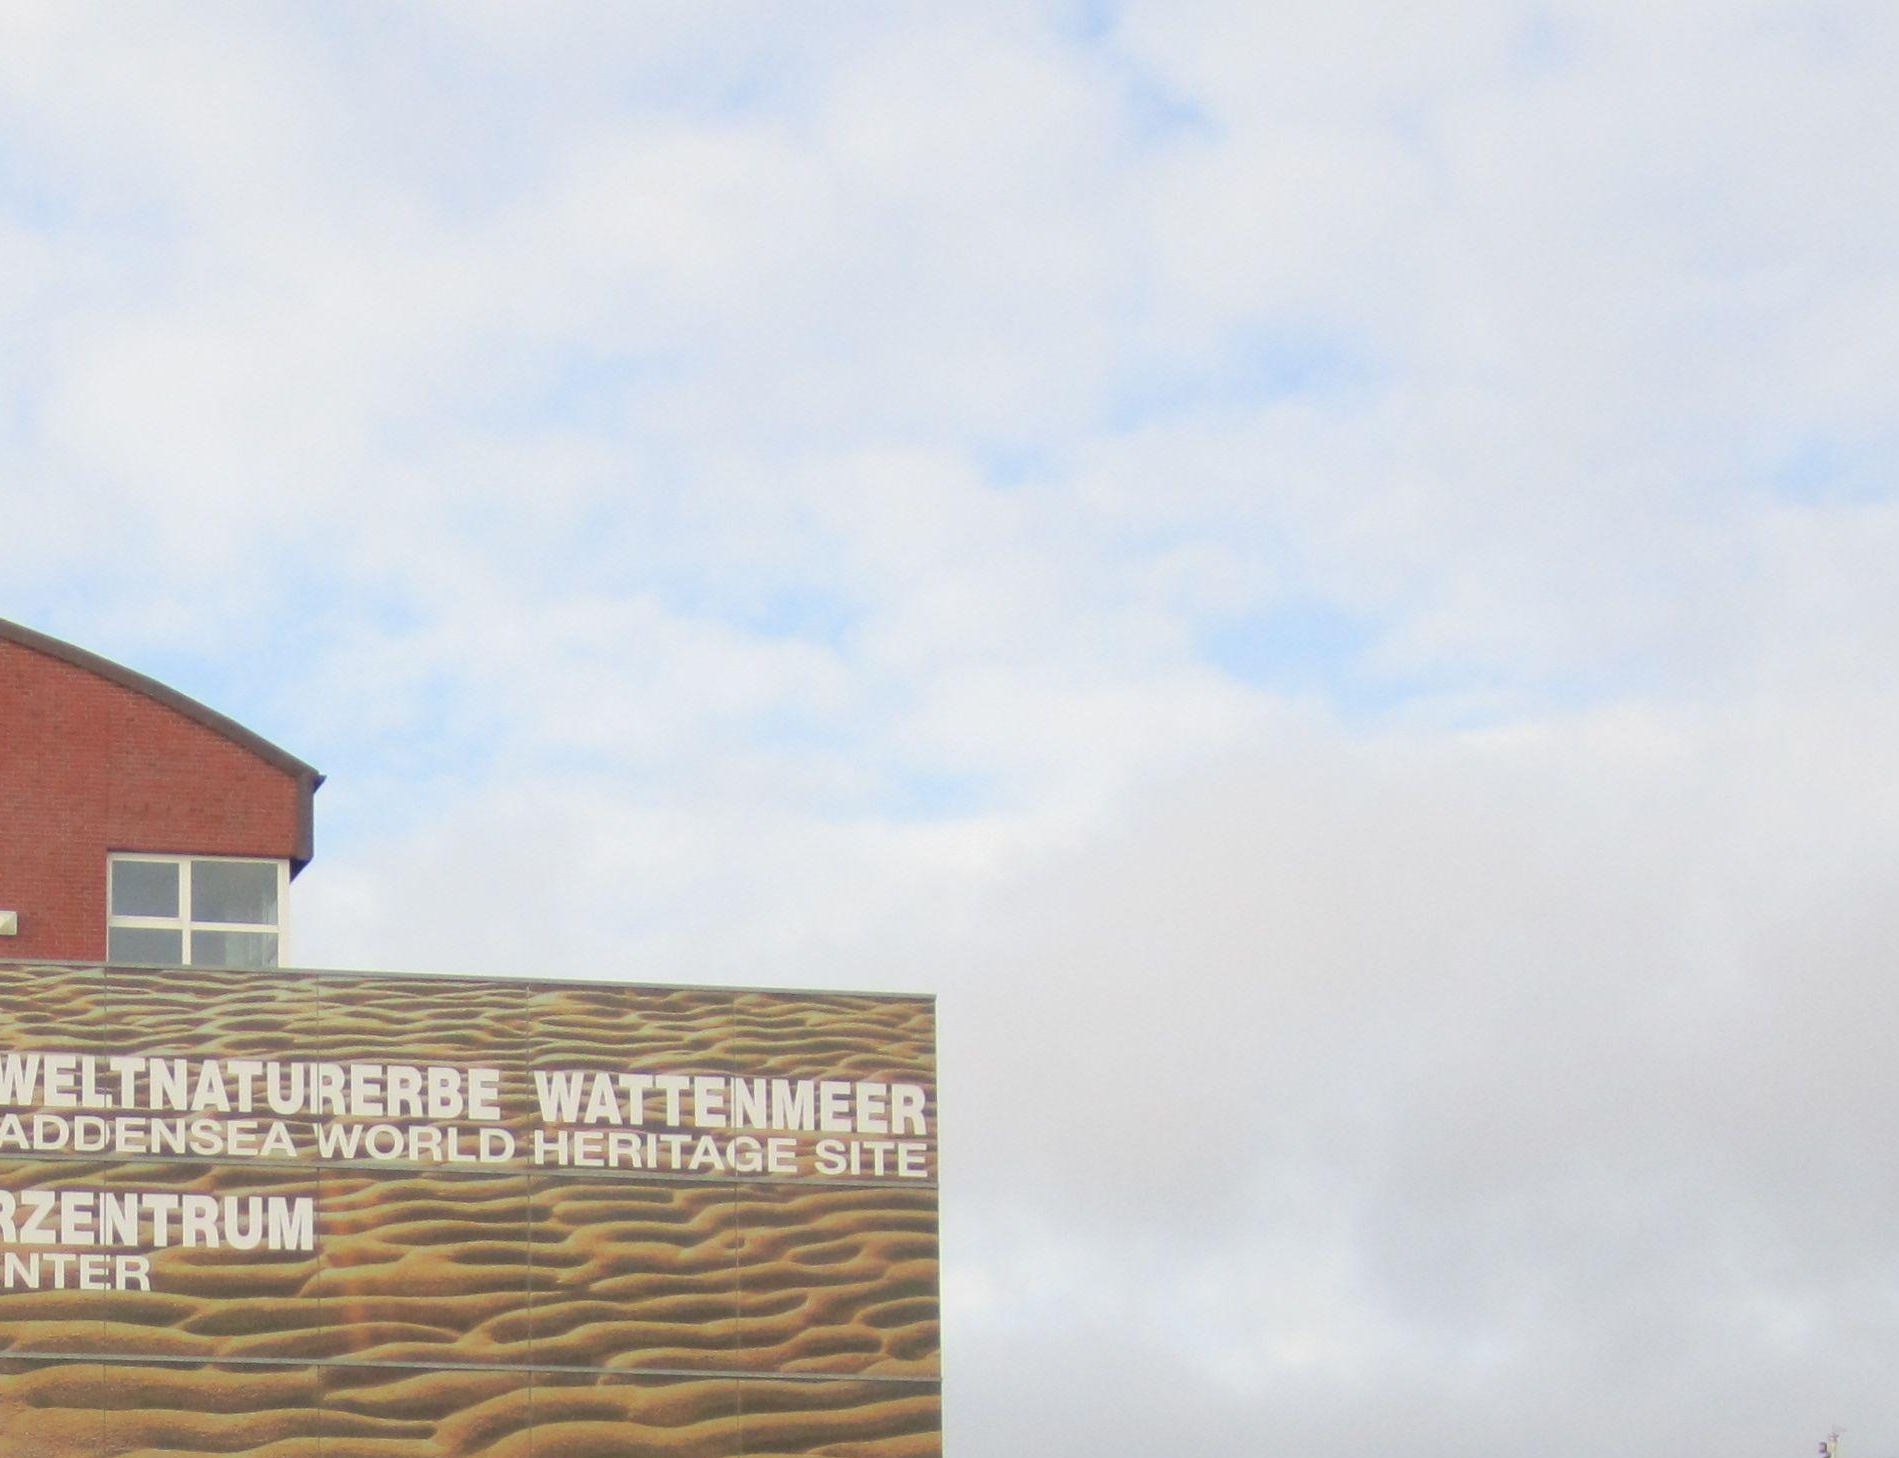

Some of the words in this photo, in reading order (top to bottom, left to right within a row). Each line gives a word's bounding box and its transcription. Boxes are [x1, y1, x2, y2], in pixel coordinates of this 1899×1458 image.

[533, 1070, 928, 1136] WATTENMEER
[313, 1122, 516, 1165] WORLD
[534, 1129, 797, 1175] HERITAGE
[814, 1138, 928, 1179] SITE
